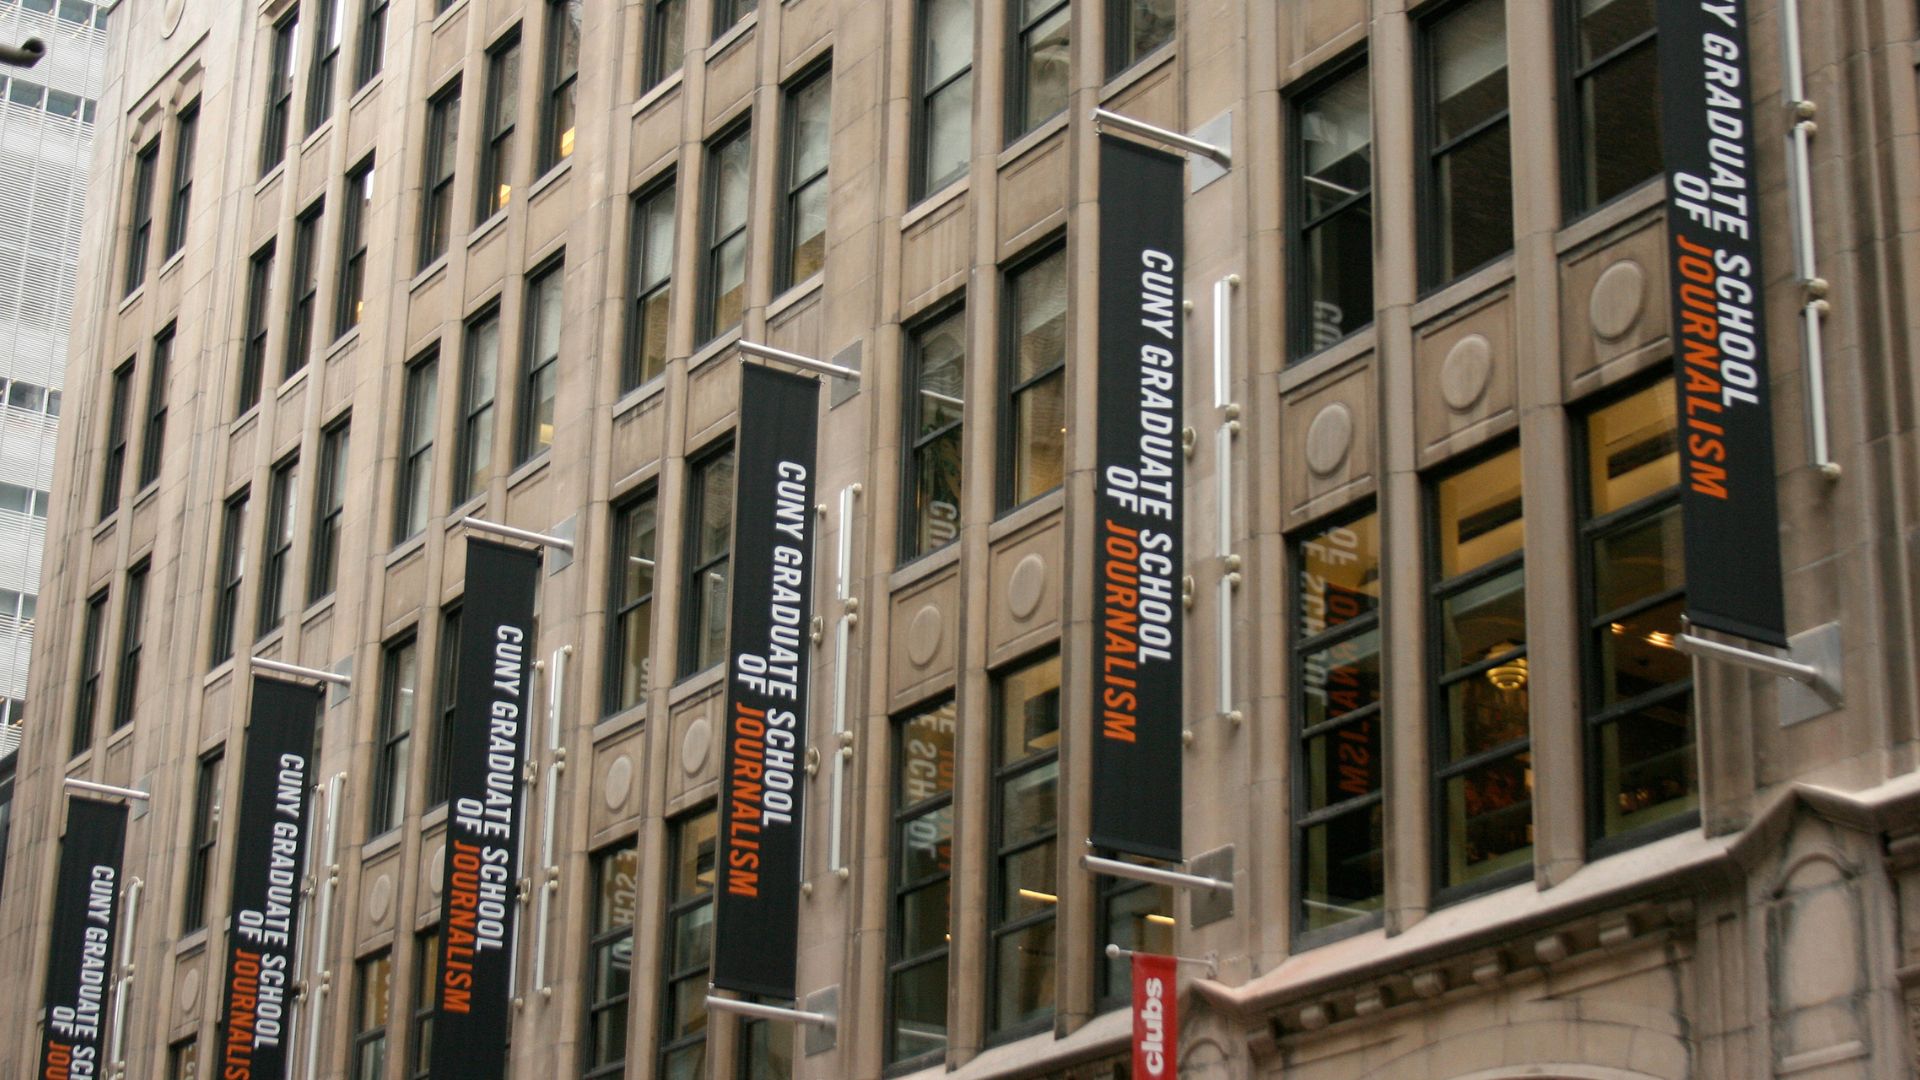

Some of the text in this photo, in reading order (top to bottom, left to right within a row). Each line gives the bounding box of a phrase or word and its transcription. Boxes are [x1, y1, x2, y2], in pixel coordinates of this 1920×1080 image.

[1702, 32, 1749, 240] GRADUATE
[1673, 171, 1728, 499] OF JOURNALISM
[1714, 249, 1760, 407] SCHOOL
[1138, 249, 1174, 664] CUNY GRADUATE SCHOOL
[762, 460, 807, 827] CUNY GRADUATE SCHOOL
[1103, 465, 1139, 743] OF JOURNALISM
[475, 624, 524, 952] CUNY GRADUATE SCHOOL
[728, 653, 768, 897] OF JOURNALISM
[74, 926, 109, 1040] GRADUATE
[85, 865, 115, 924] CUNY
[238, 909, 265, 943] OF
[254, 753, 305, 1049] CUNY GRADUATE SCHOOL
[443, 797, 484, 1013] OF JOURNALISM
[51, 1005, 77, 1036] OF
[1141, 977, 1164, 1076] clubs
